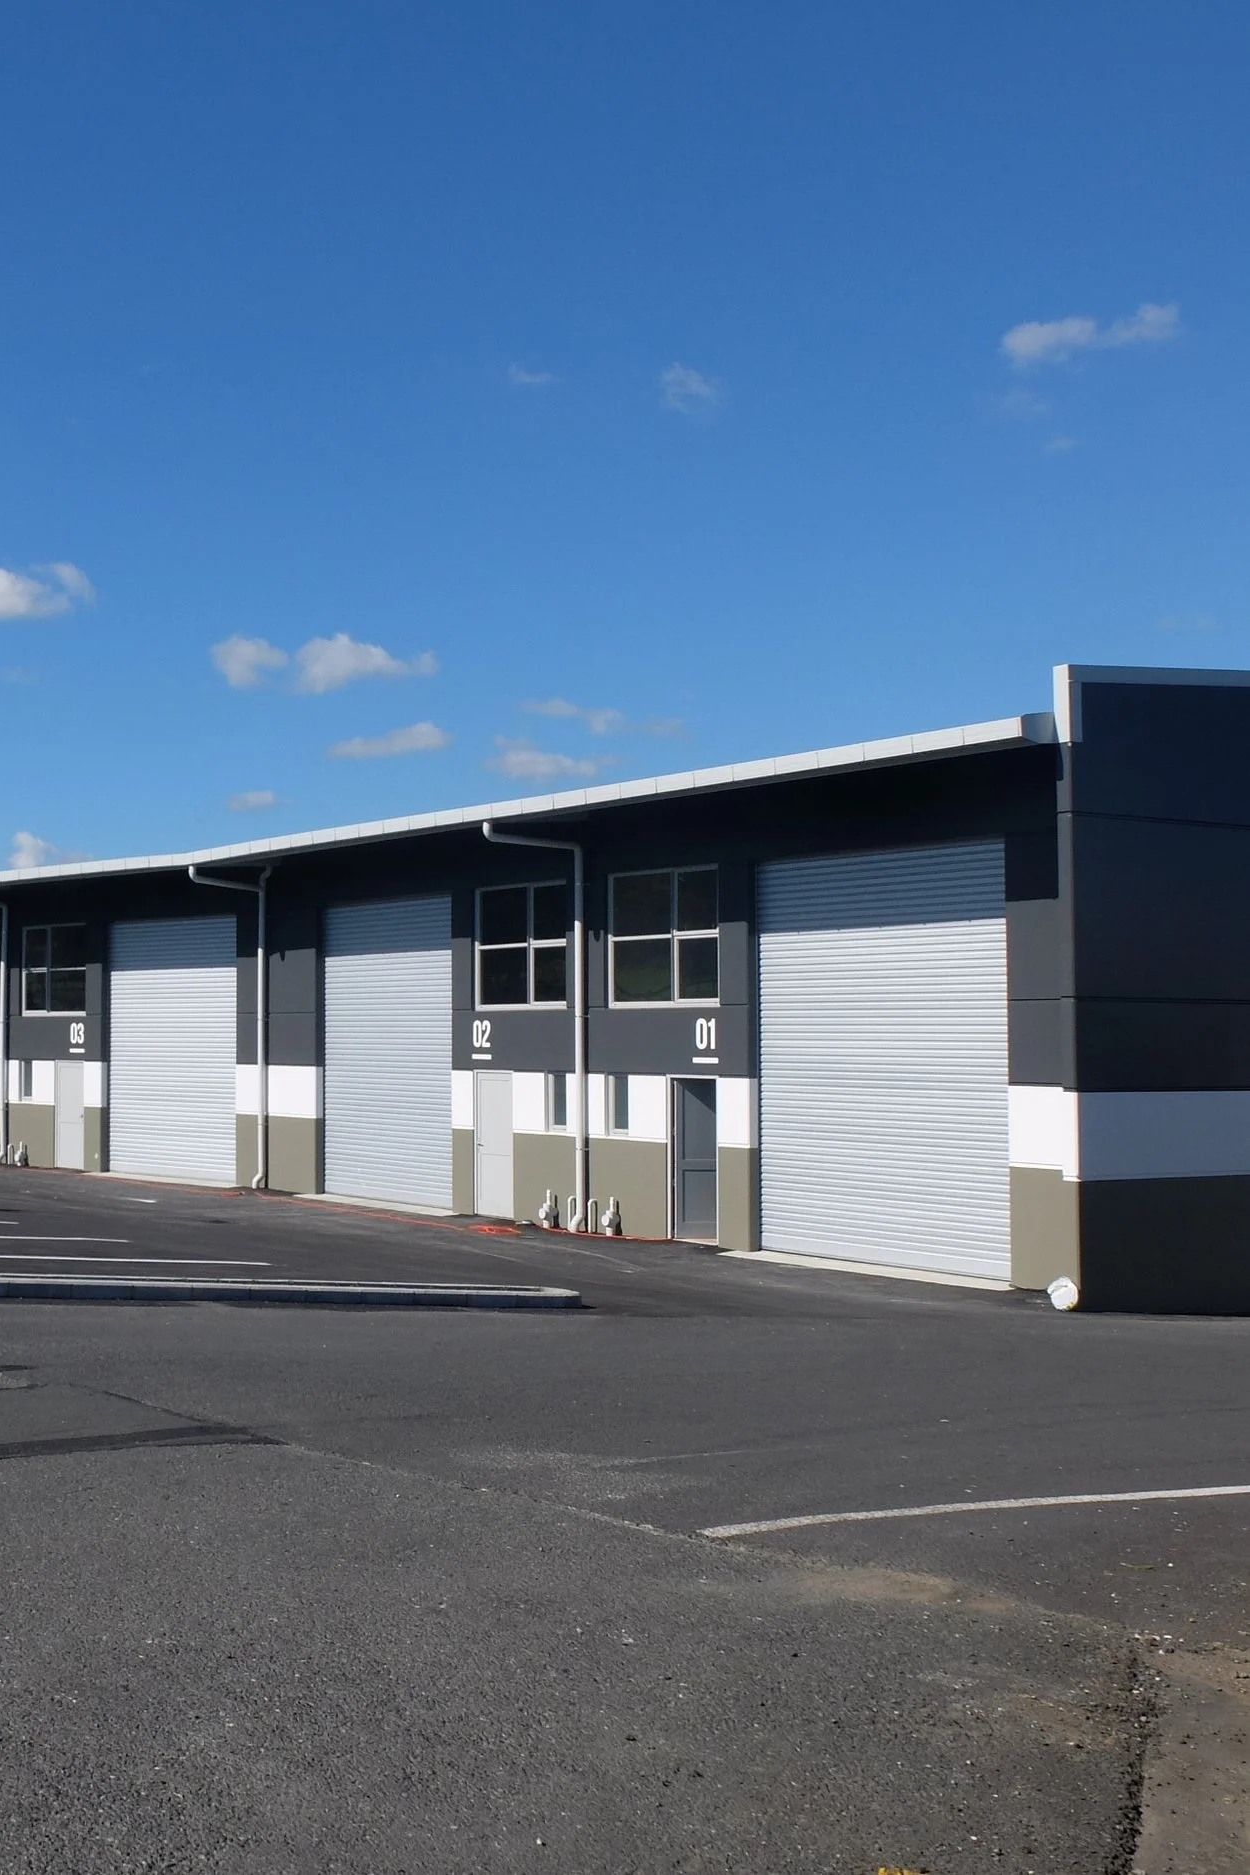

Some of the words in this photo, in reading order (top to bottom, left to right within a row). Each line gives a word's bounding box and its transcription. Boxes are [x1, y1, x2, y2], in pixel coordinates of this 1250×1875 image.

[70, 1022, 85, 1044] 03
[472, 1020, 491, 1048] 02
[695, 1018, 716, 1050] 01
